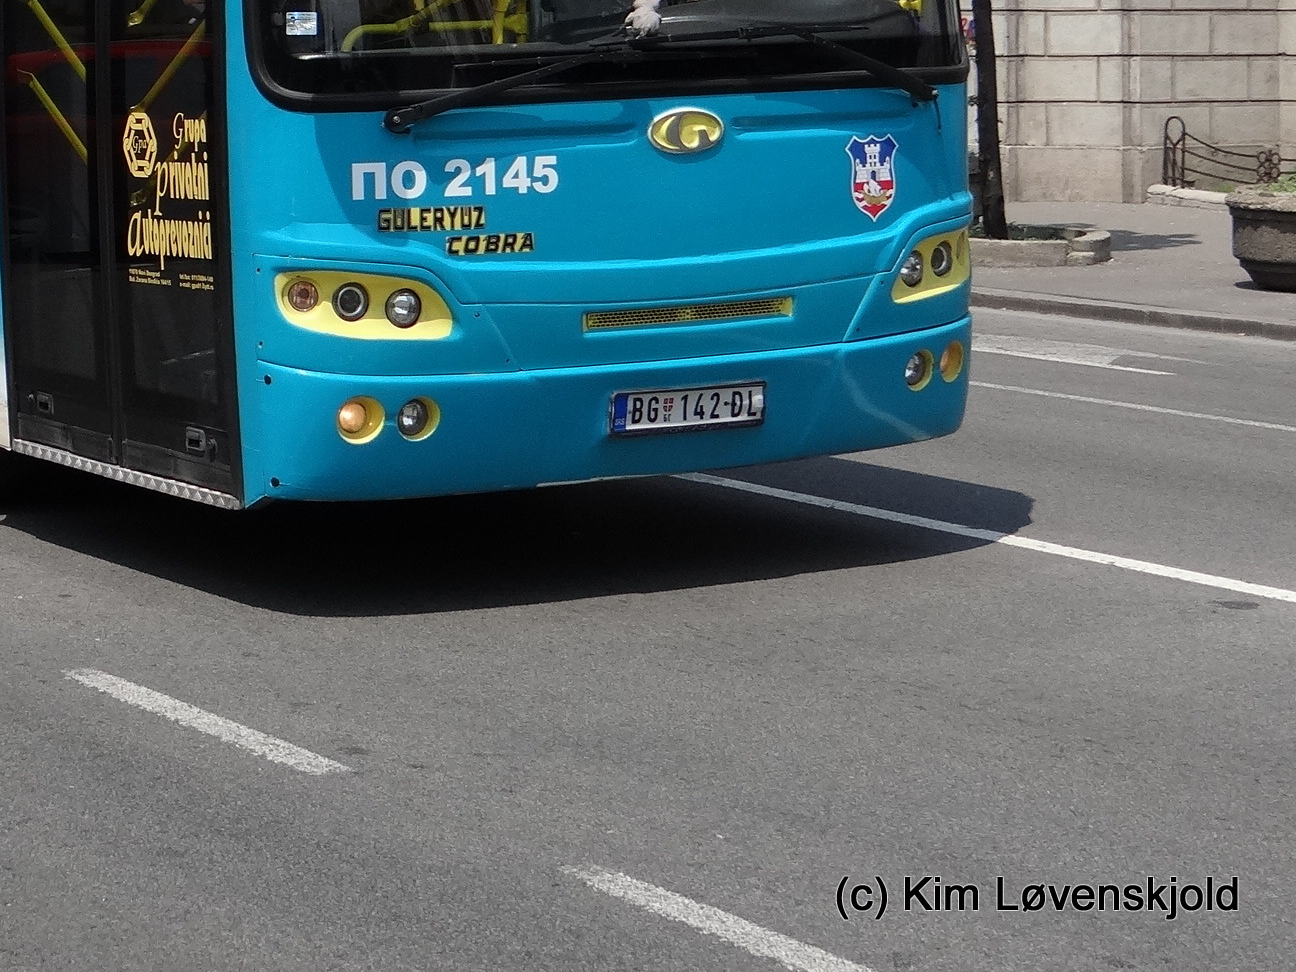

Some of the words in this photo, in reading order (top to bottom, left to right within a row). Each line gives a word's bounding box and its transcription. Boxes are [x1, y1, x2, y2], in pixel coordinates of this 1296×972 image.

[173, 112, 207, 152] Grupa
[444, 155, 559, 197] 2145
[446, 233, 535, 256] COBRA
[631, 396, 659, 424] BG
